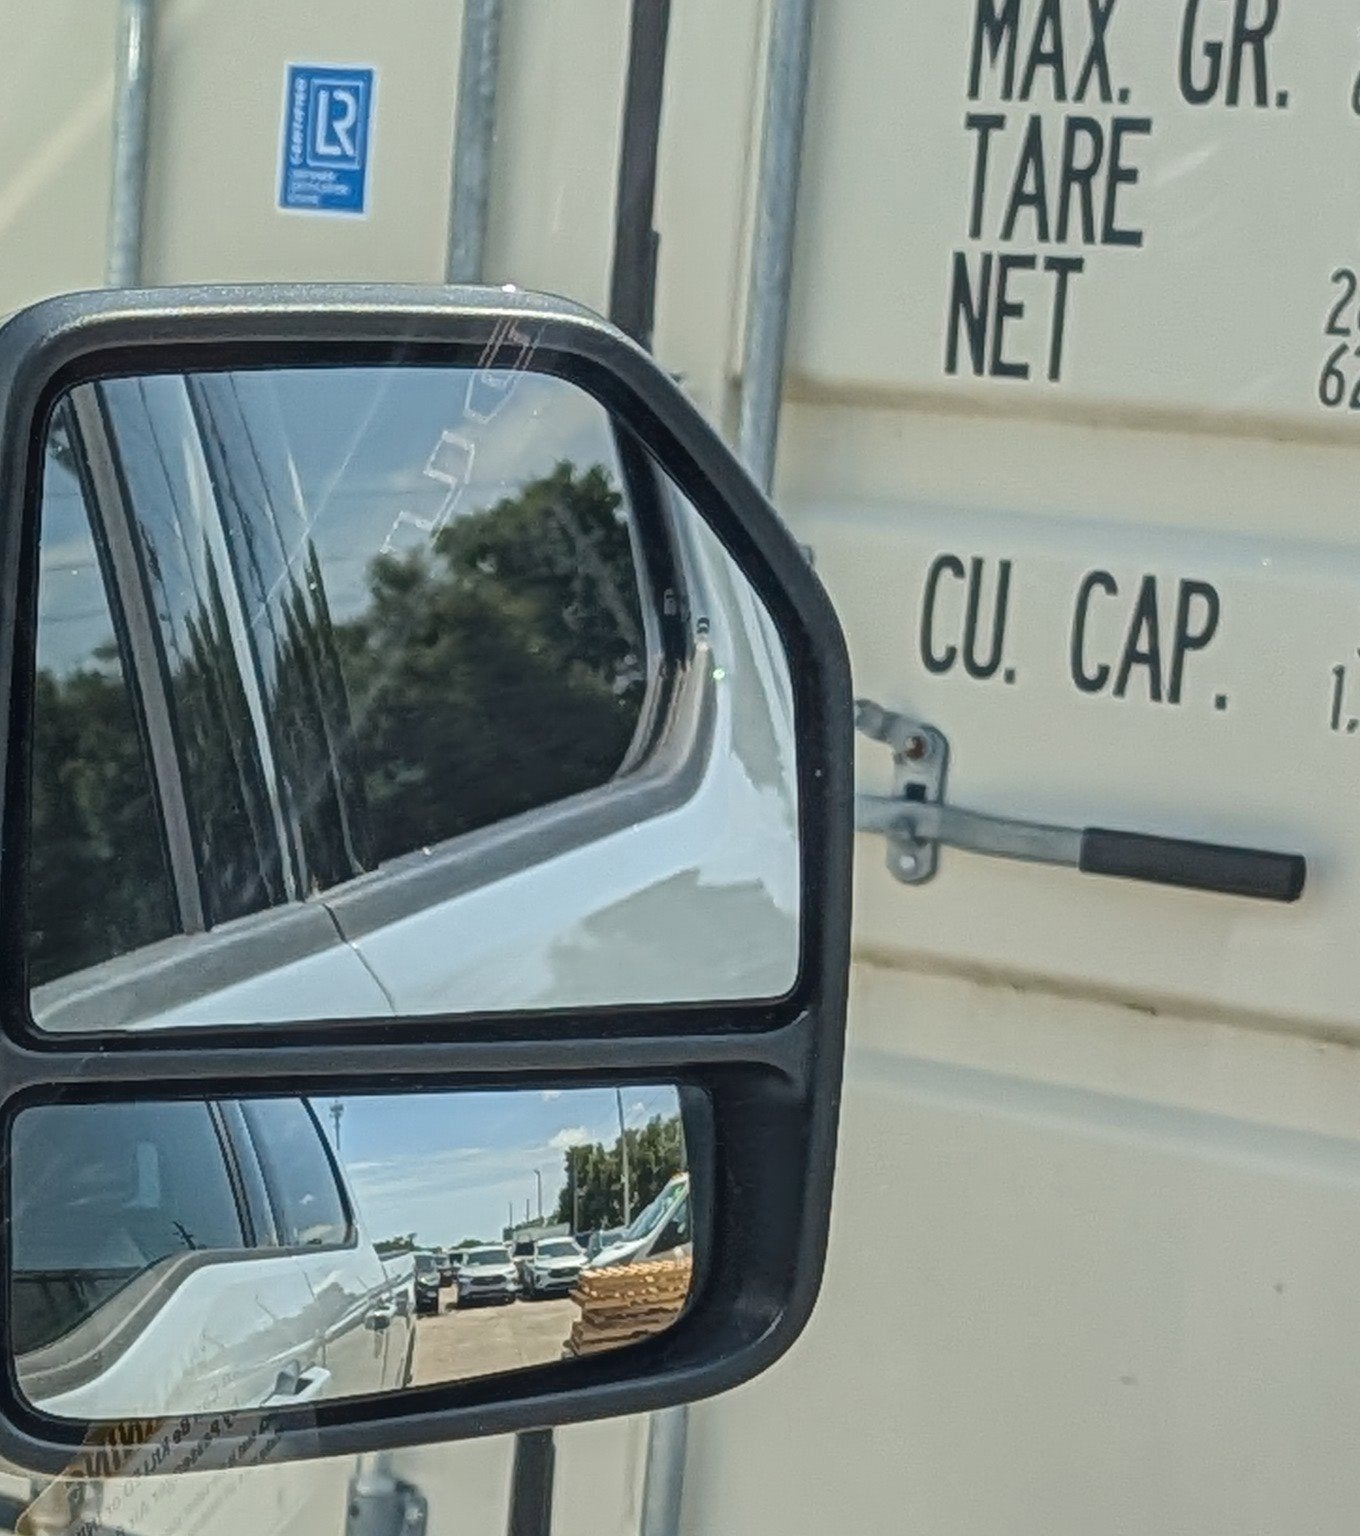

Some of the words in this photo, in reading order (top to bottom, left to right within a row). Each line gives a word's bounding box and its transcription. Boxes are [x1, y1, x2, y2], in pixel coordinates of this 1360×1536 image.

[967, 0, 1131, 103] MAX.
[1180, 0, 1288, 109] GR.
[314, 89, 357, 157] LR
[966, 113, 1152, 247] TARE
[945, 252, 1085, 382] NET
[1326, 268, 1360, 336] 2
[920, 554, 1017, 684] CU.
[1070, 570, 1228, 711] CAP.
